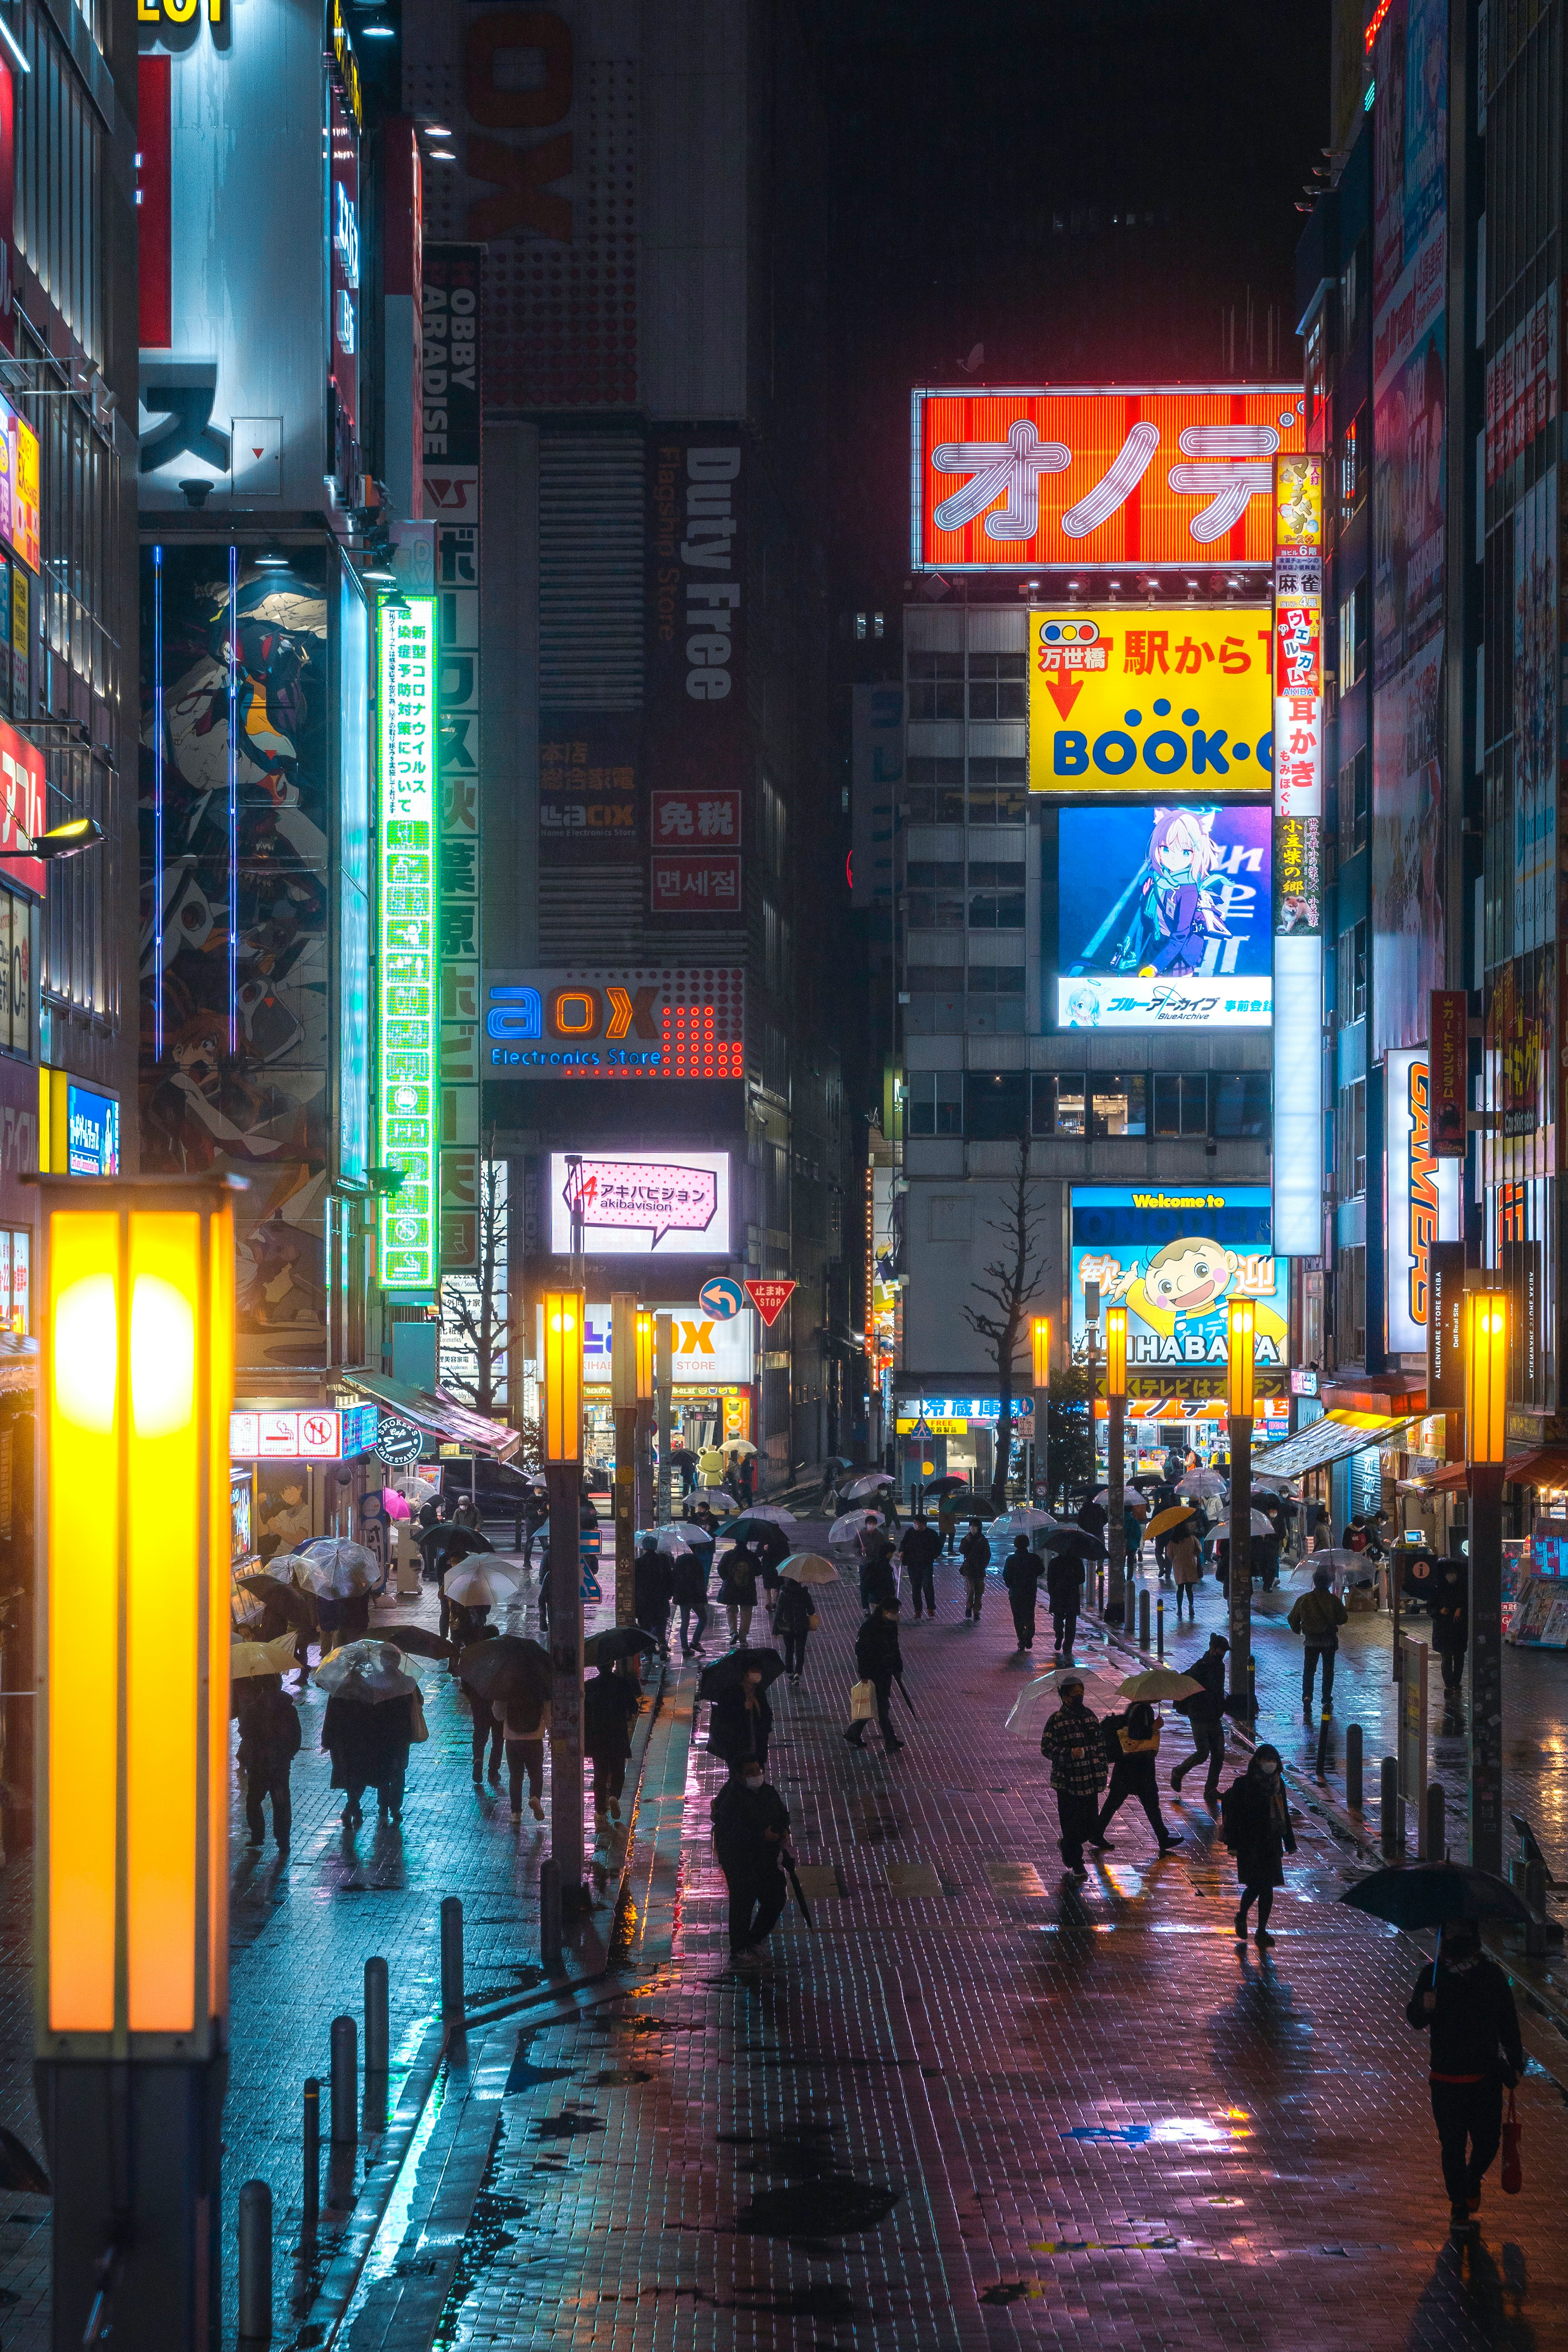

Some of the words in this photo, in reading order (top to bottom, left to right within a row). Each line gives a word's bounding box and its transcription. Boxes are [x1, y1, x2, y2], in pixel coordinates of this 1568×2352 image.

[450, 261, 475, 391] HOBBY
[423, 261, 448, 456] PARADISE
[1310, 458, 1320, 486] 三人打
[686, 448, 741, 567] Duty
[1281, 546, 1317, 557] 当ビル6階
[1278, 573, 1321, 594] 麻雀
[658, 569, 677, 642] Store
[1281, 597, 1317, 608] 当ビル4階
[686, 583, 741, 701] Free
[1040, 647, 1107, 669] 万世橋
[1283, 688, 1314, 696] AKIBA
[1288, 697, 1317, 787] 耳かき
[1280, 750, 1291, 817] もみほぐし
[659, 801, 734, 836] 免税
[1282, 819, 1304, 896] 小豆柴の郷
[657, 870, 735, 897] 면세점
[492, 1049, 599, 1066] Electronics
[608, 1049, 661, 1066] Store
[601, 1184, 705, 1203] アキバビジョン
[1131, 1194, 1206, 1208] Welcome
[1207, 1194, 1225, 1208] to
[601, 1200, 672, 1212] akibavision
[755, 1285, 786, 1297] 止まれ
[760, 1298, 782, 1307] STOP
[676, 1361, 715, 1370] STORE
[922, 1400, 1000, 1417] 冷蔵庫
[389, 1428, 406, 1438] Cafe
[378, 1446, 394, 1462] VAPE
[394, 1448, 417, 1463] STAND
